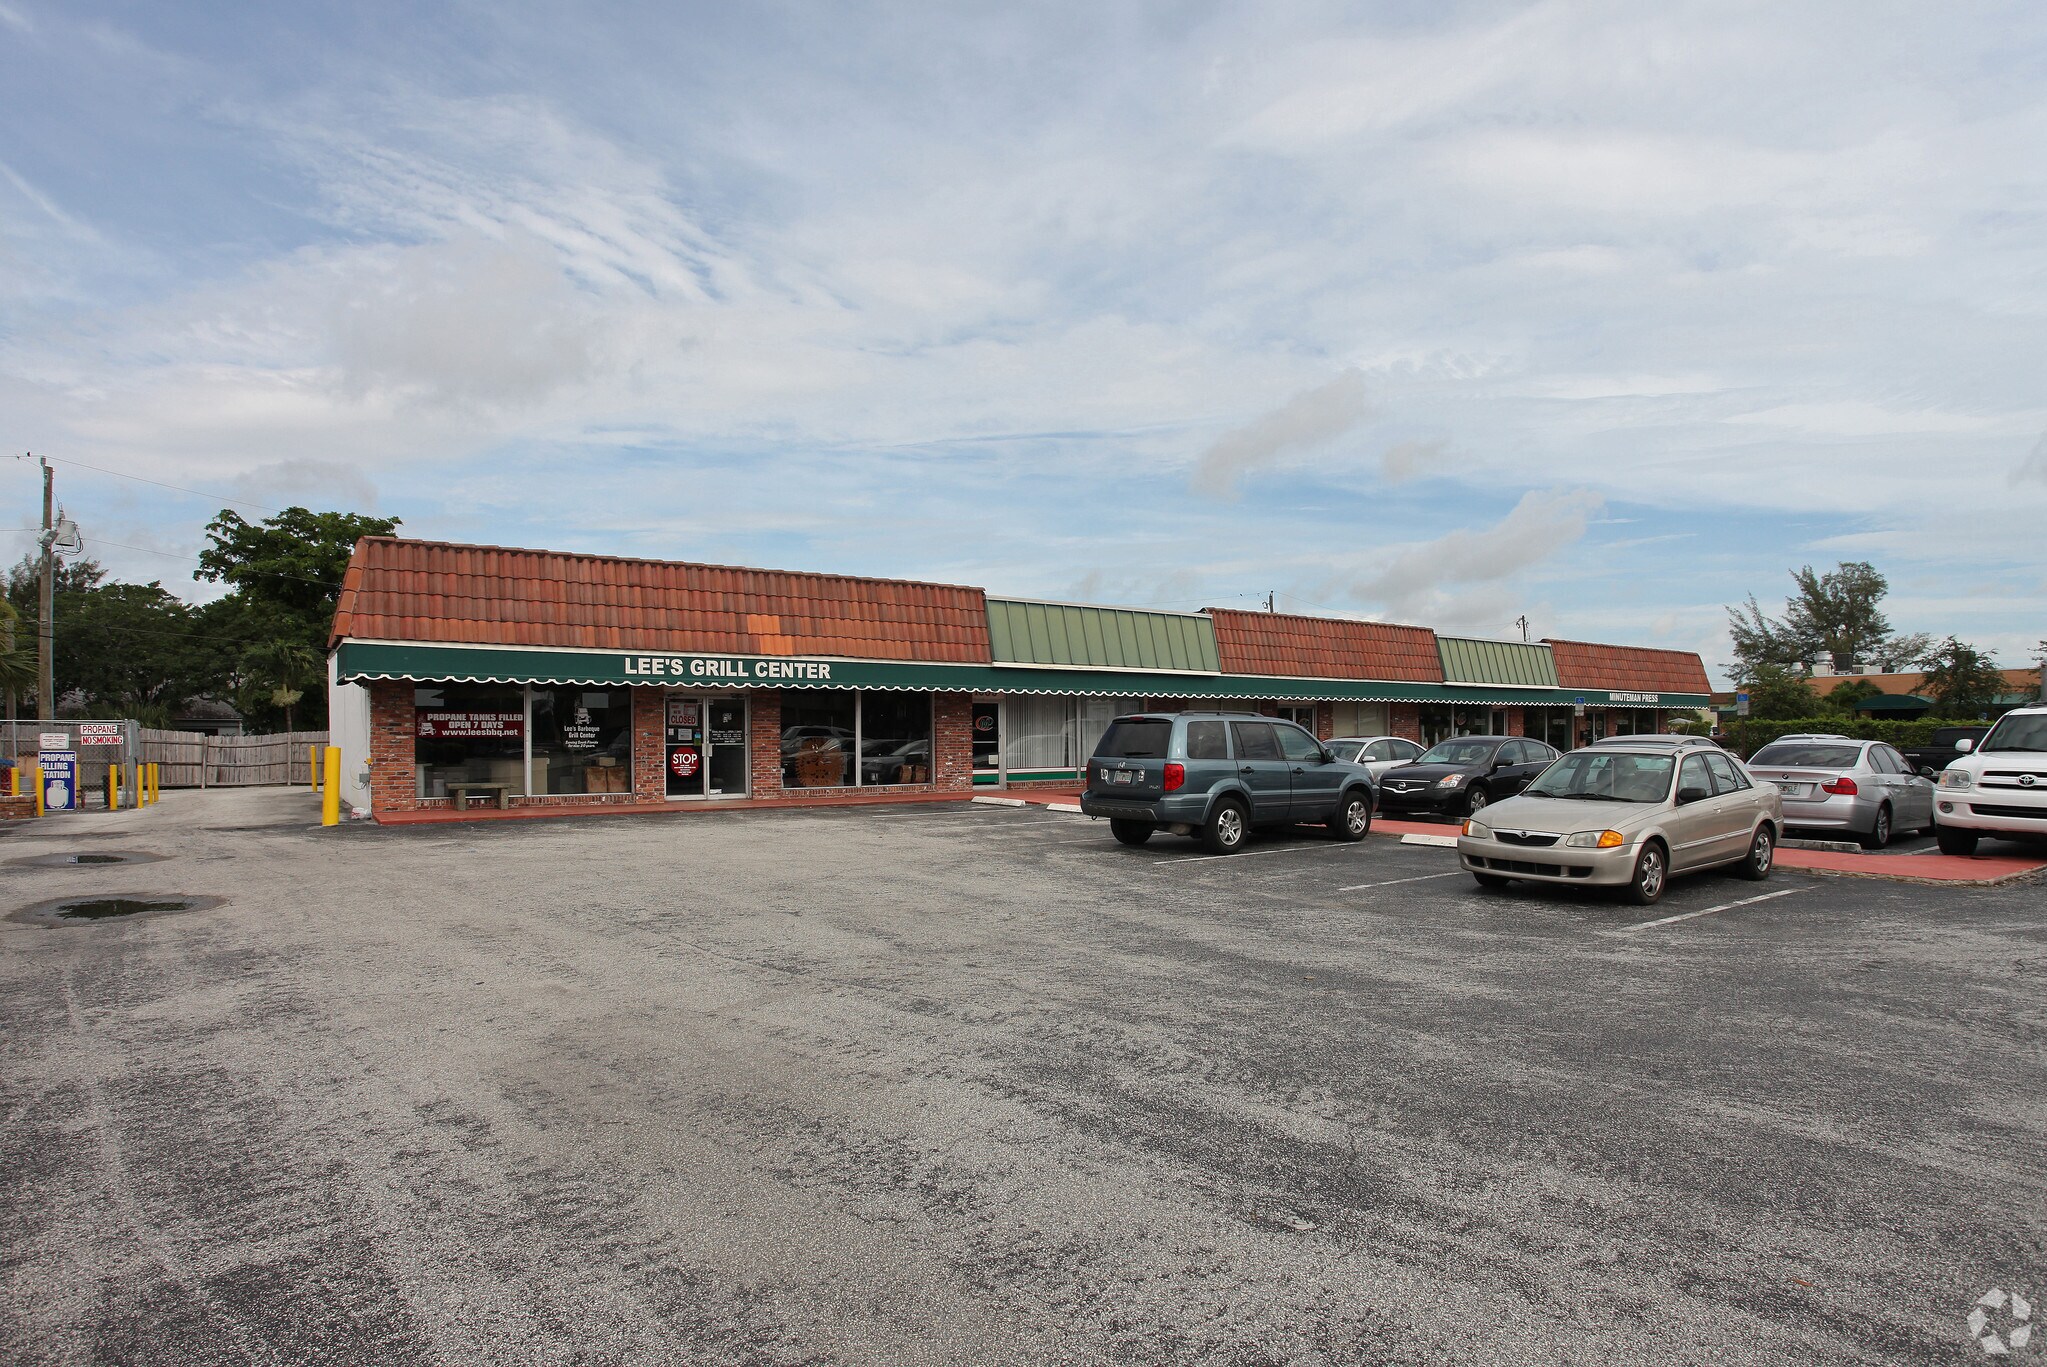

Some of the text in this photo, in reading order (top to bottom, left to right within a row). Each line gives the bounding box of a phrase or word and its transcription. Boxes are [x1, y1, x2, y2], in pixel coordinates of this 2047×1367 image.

[625, 657, 831, 679] LEE'S GRILL CENTER
[1609, 693, 1659, 702] MINUTEMAN PRESS
[427, 713, 523, 721] PROPANE TANKS FILLED
[671, 715, 696, 724] CLOSED
[82, 725, 117, 734] PROPANE
[448, 721, 504, 729] OPEN 7 DAYS
[577, 725, 600, 733] Barbeque
[441, 728, 518, 737] www.leesbbq.net
[82, 735, 123, 745] NO SMOKING
[40, 753, 75, 762] PROPANE
[672, 753, 698, 764] STOP
[40, 762, 68, 770] FILLING
